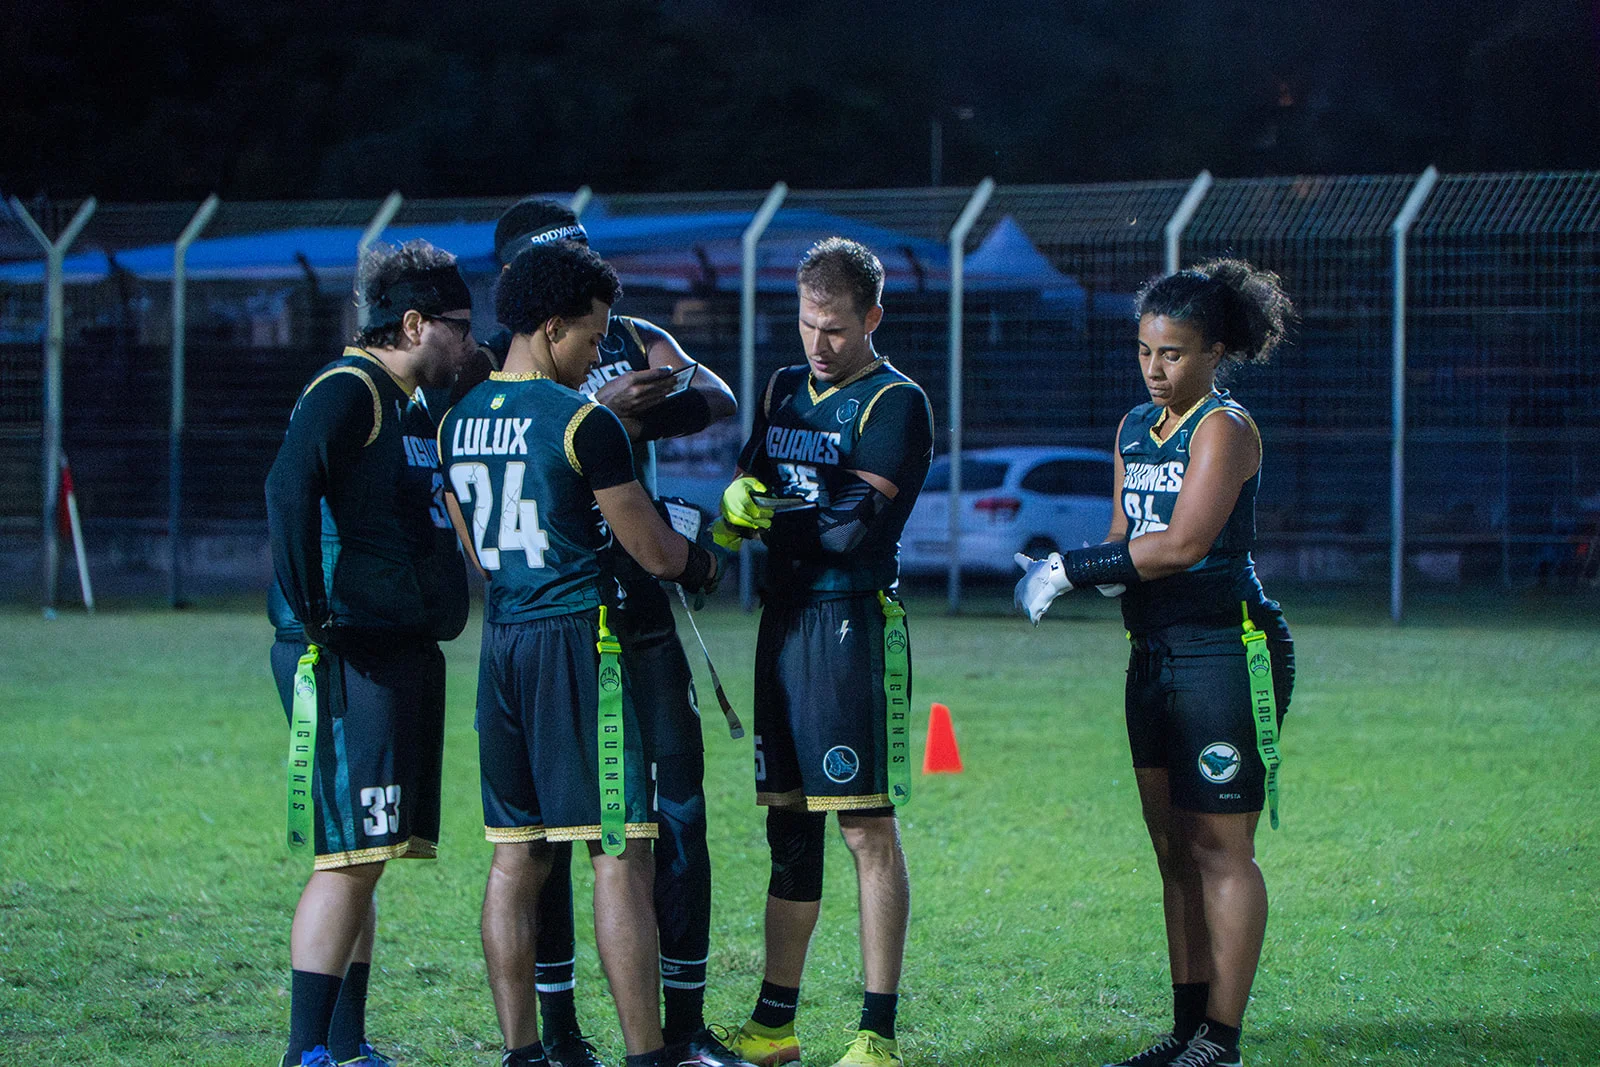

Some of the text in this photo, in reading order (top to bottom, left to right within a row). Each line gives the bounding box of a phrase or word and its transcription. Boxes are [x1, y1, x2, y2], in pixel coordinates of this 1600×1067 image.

[452, 418, 532, 457] LULUX
[766, 425, 841, 465] IGUANES
[449, 461, 550, 571] 24
[890, 673, 905, 764] IGUANES
[1256, 689, 1271, 723] FLAG
[293, 720, 311, 811] IGUANES
[604, 713, 620, 811] IGUANES
[1261, 729, 1280, 796] FOOTBALL
[360, 784, 402, 837] 33
